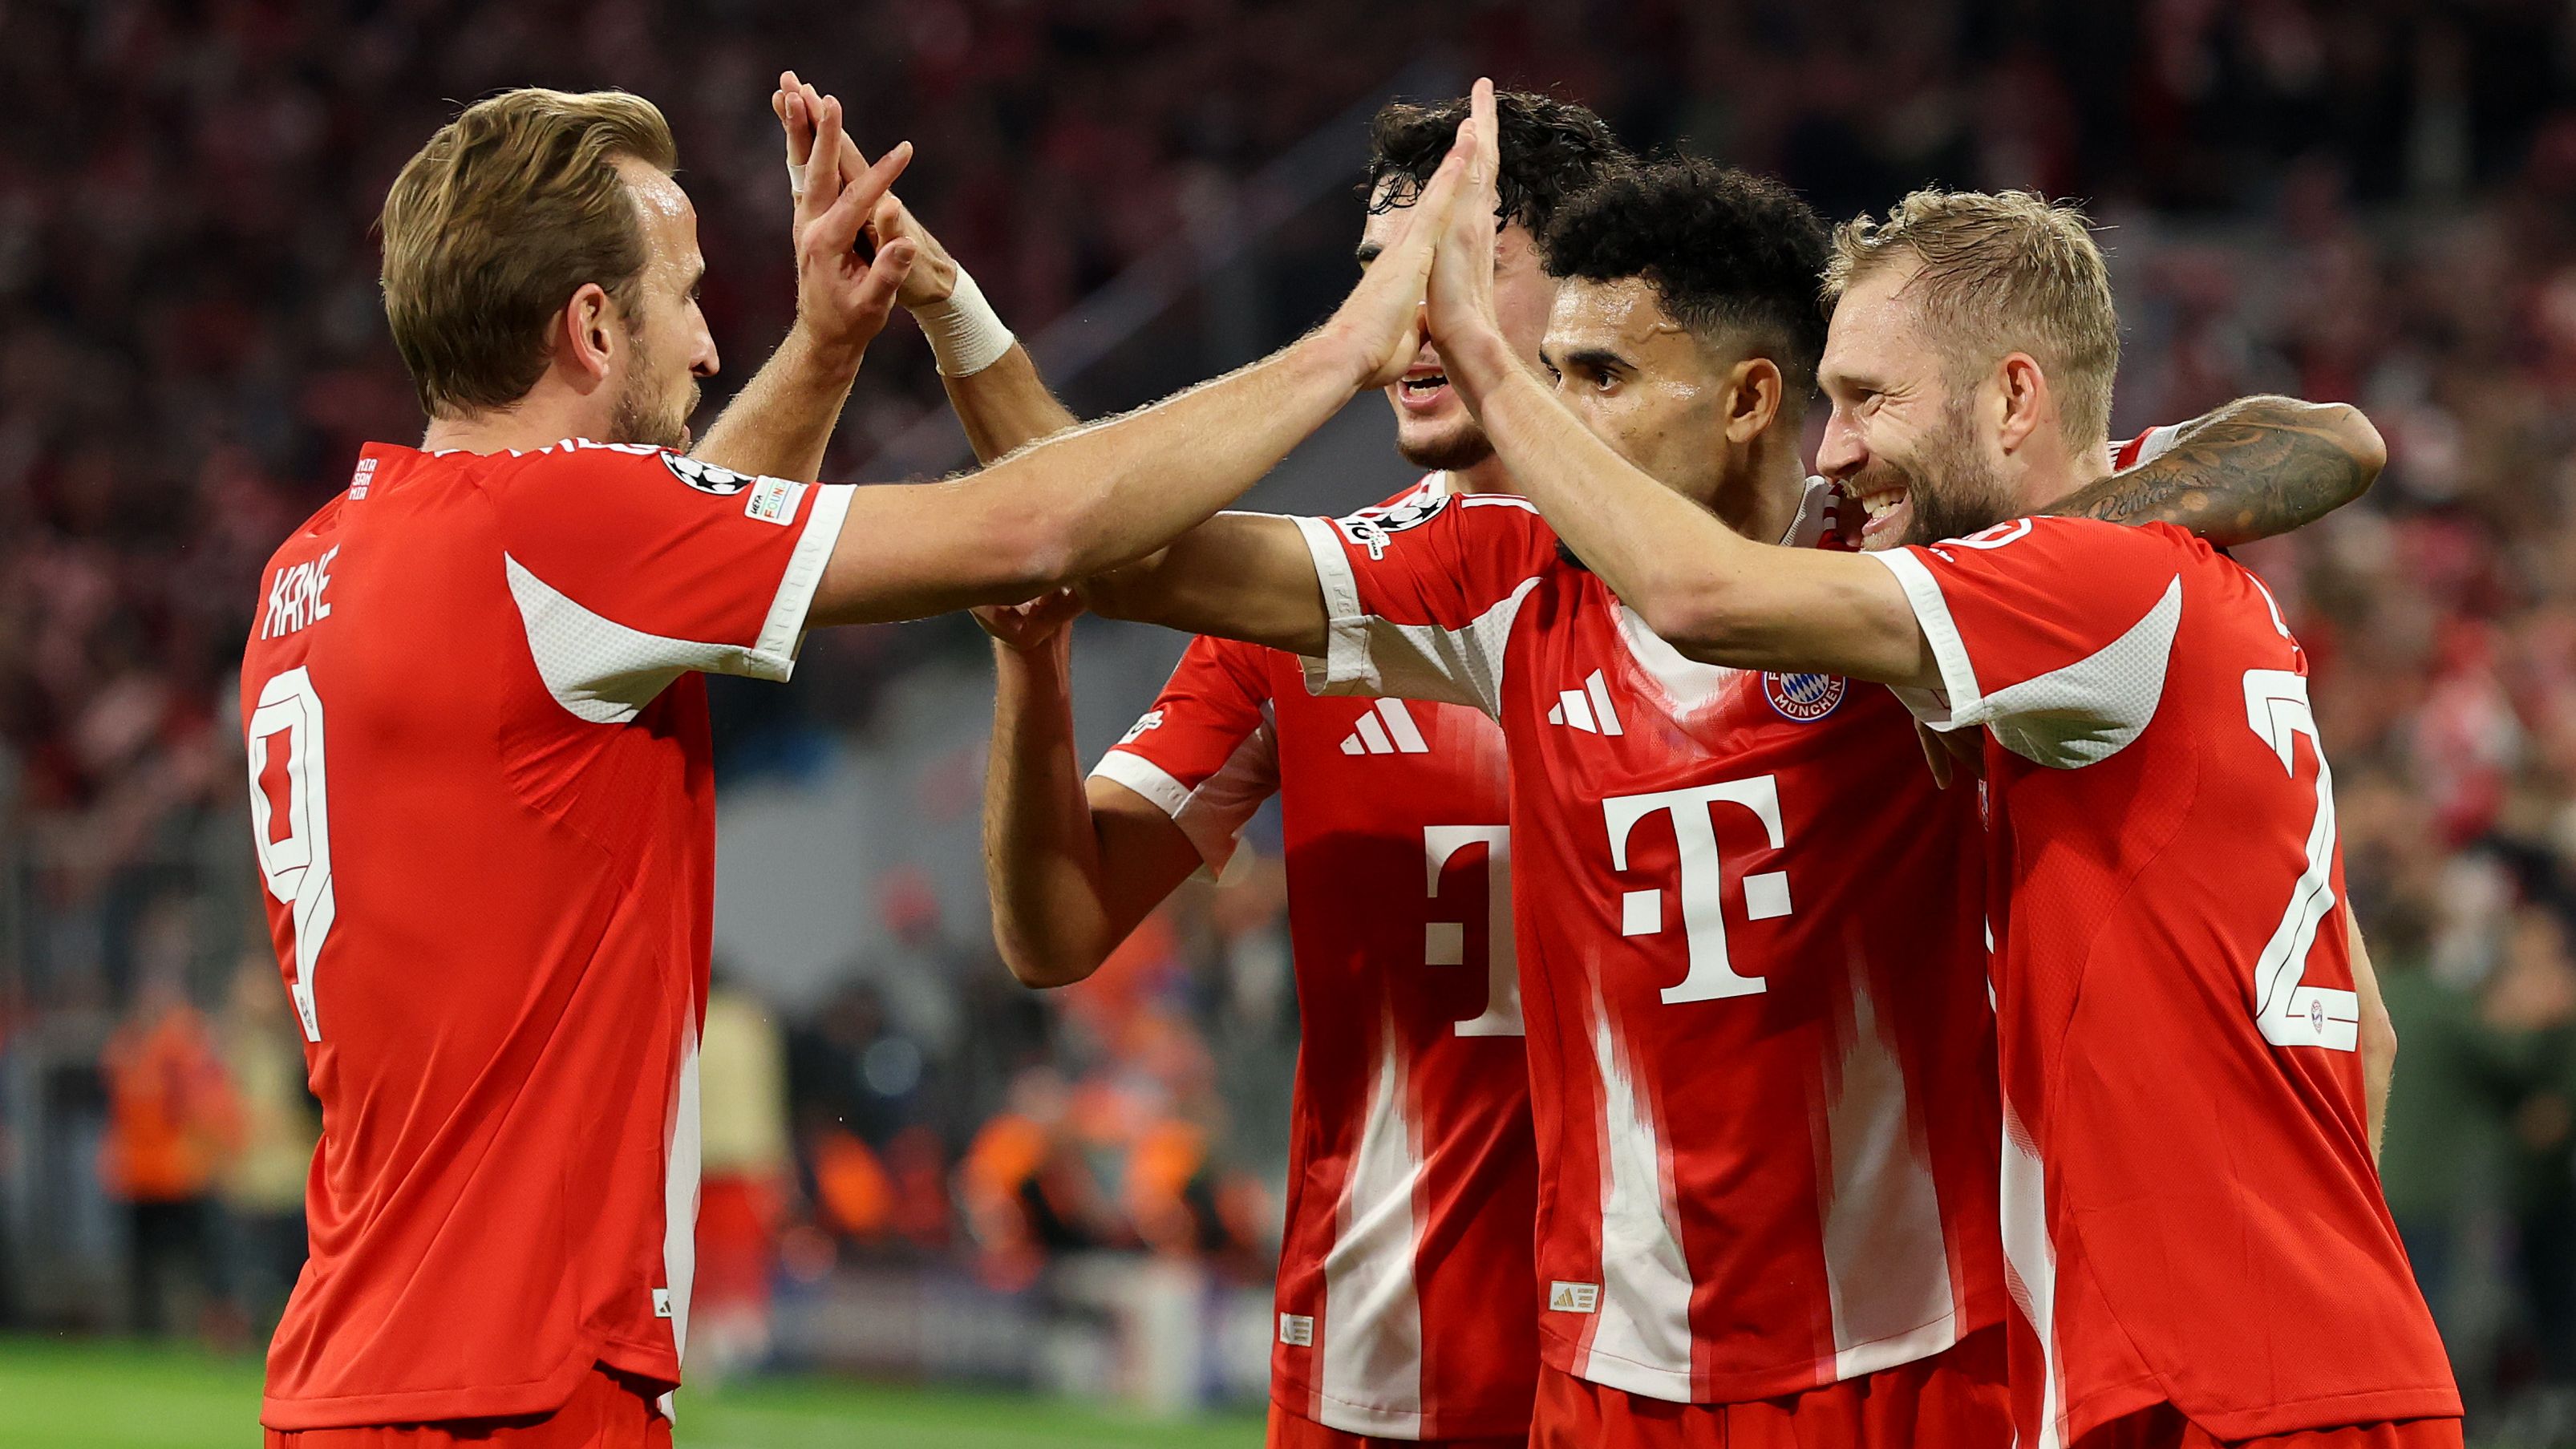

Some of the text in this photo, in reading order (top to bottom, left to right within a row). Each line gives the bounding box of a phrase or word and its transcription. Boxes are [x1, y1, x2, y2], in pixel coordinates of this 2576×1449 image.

[357, 458, 378, 472] MIA
[352, 472, 373, 486] SAN
[348, 486, 368, 500] MIA
[751, 495, 763, 514] UEFA
[1345, 521, 1372, 540] 10
[261, 544, 340, 640] KANE
[1775, 681, 1841, 716] MÜNCHEN
[248, 665, 335, 1042] 9
[1602, 774, 1792, 1005] T
